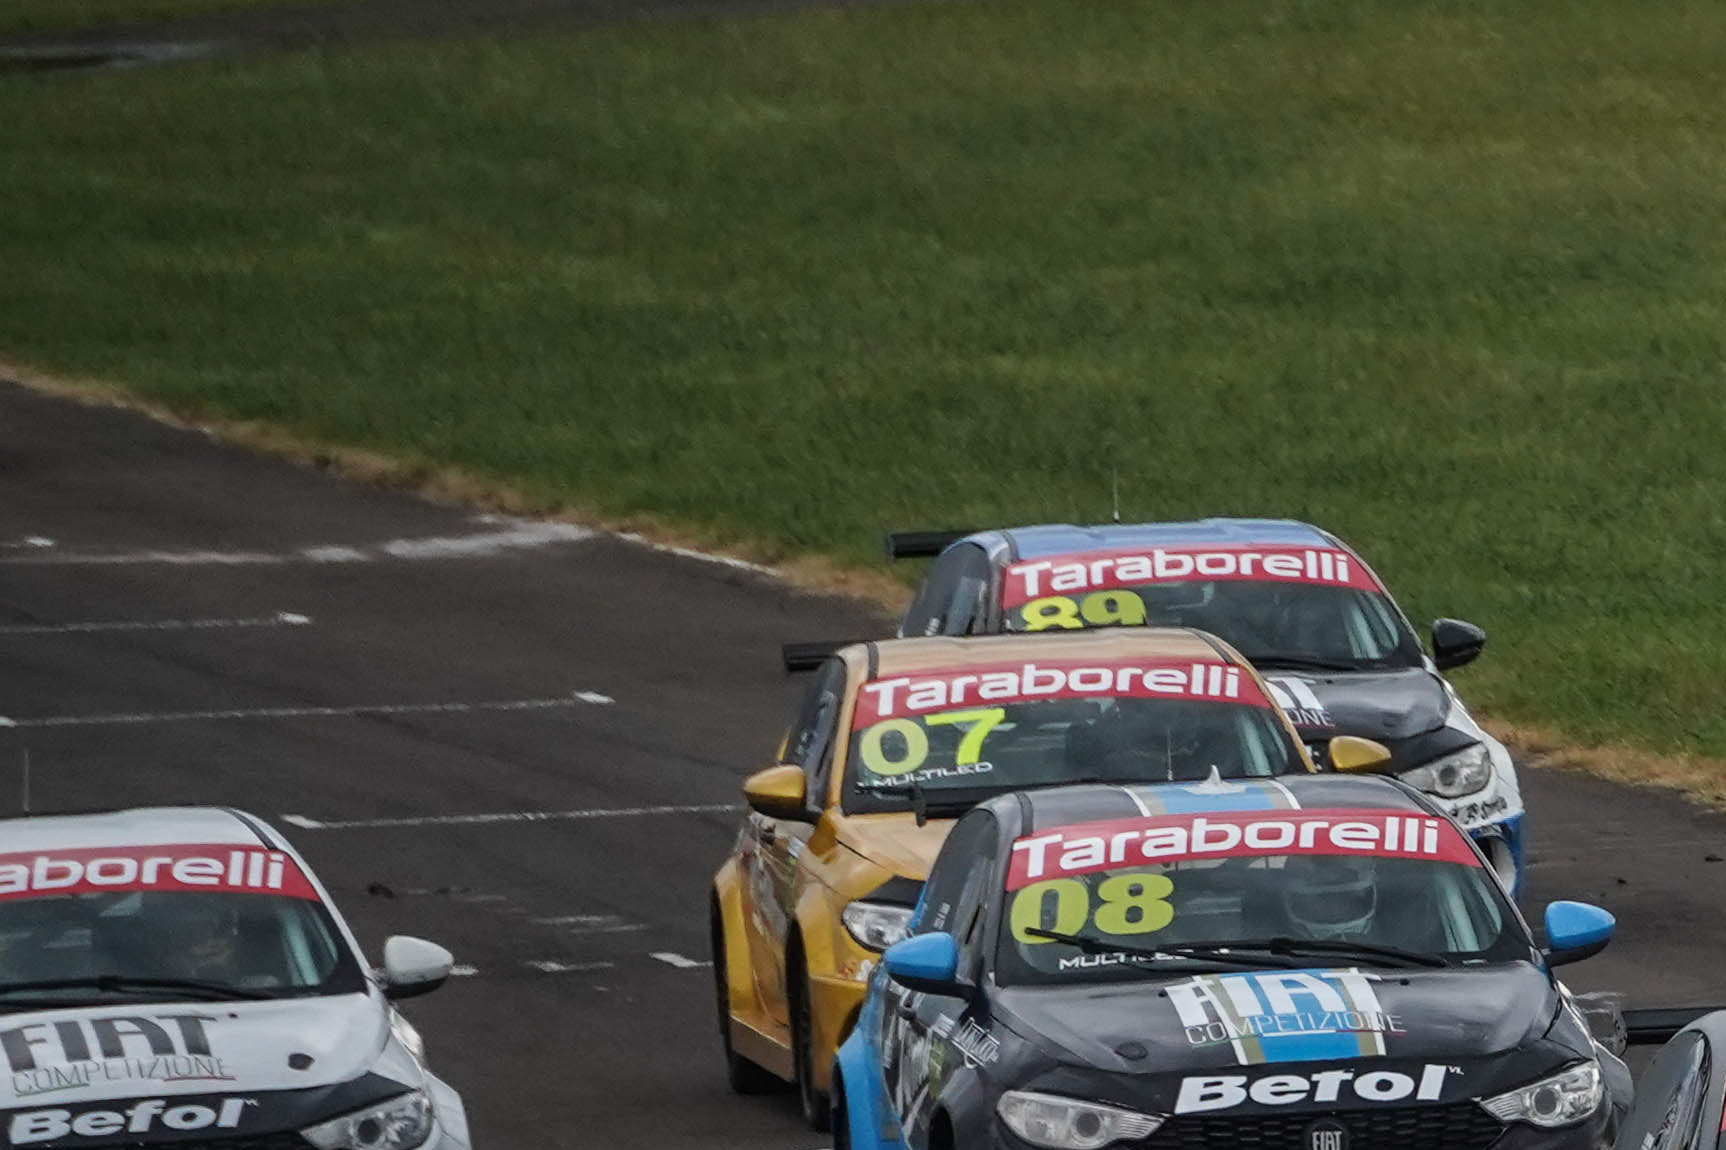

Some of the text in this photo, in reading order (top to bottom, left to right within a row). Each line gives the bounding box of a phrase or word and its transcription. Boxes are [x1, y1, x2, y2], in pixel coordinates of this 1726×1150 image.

[1009, 547, 1350, 598] Taraborelli
[864, 663, 1240, 717] Taraborelli
[859, 707, 1006, 776] 07
[1011, 816, 1440, 879] Taraborelli
[1010, 873, 1175, 945] 08
[1164, 970, 1383, 1026] FIAT
[0, 1014, 218, 1073] FIAT
[1184, 1011, 1408, 1046] COMPETIZIONE
[12, 1054, 234, 1095] COMPETIZIONE
[9, 1098, 245, 1145] Befol
